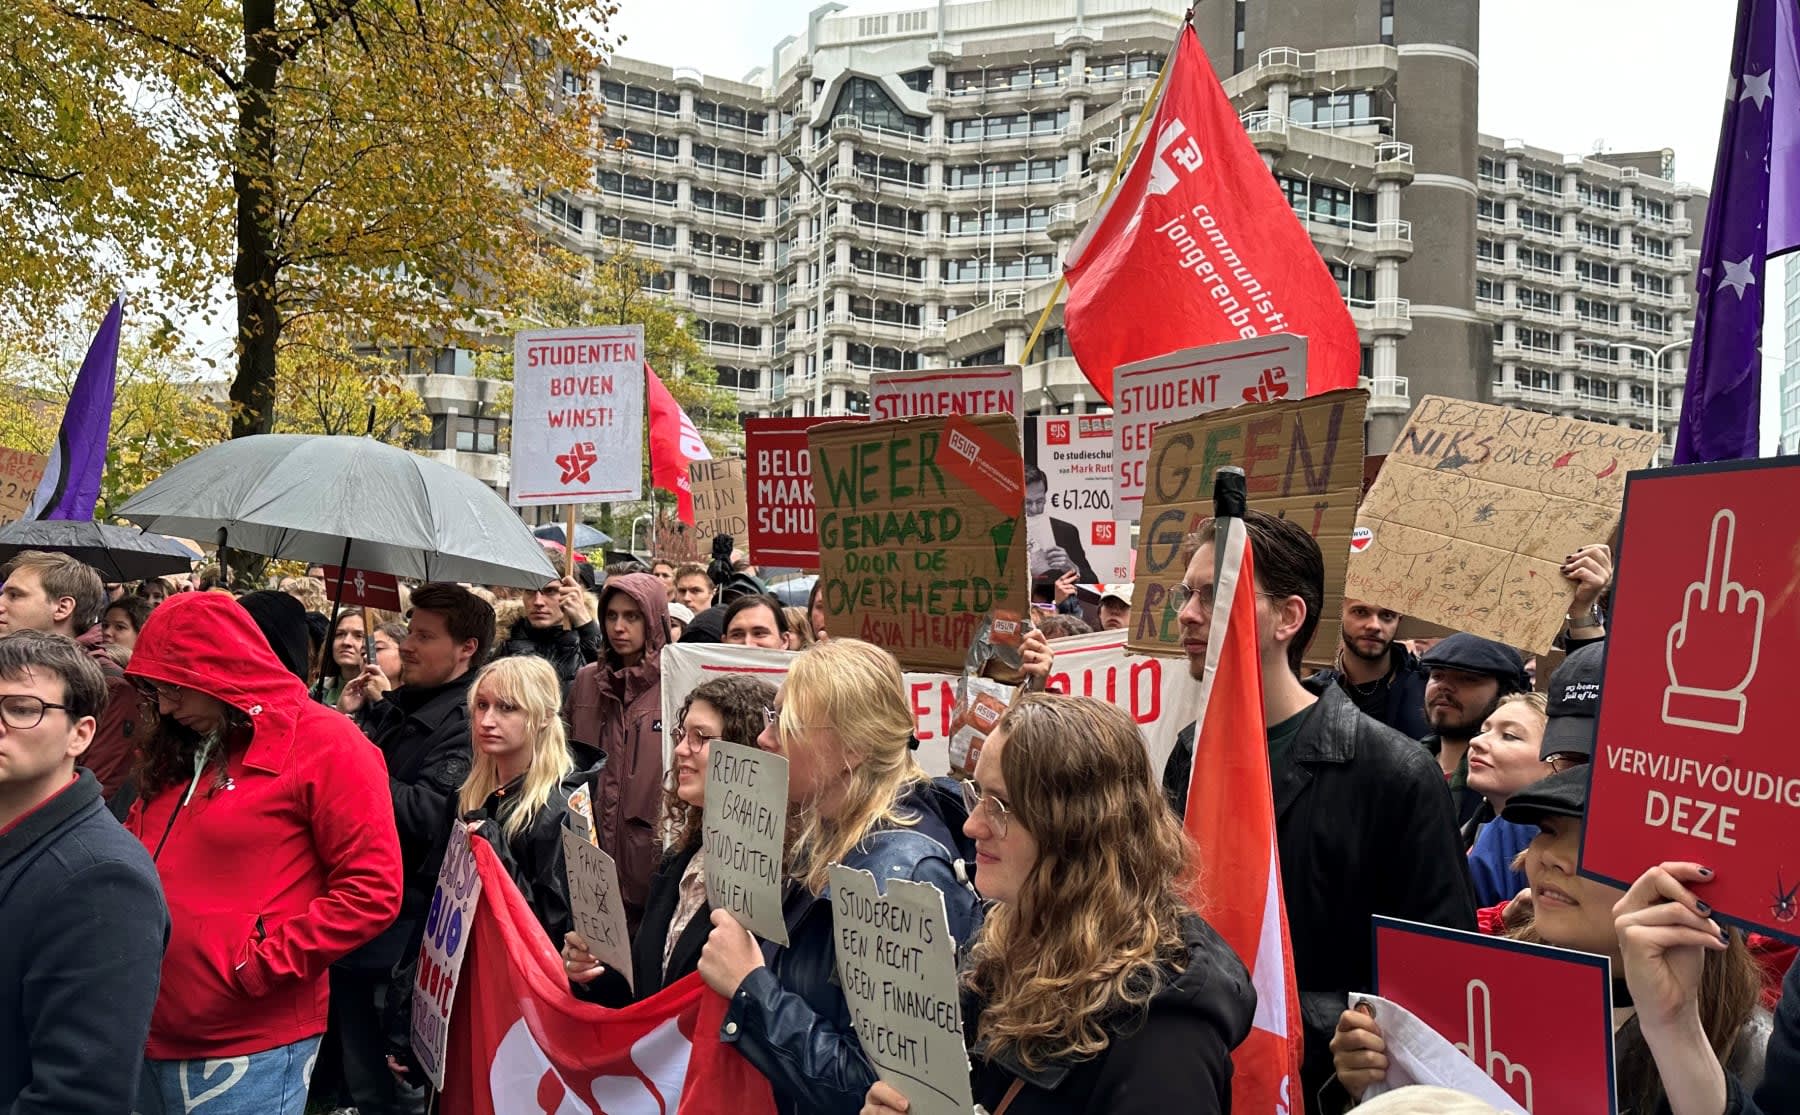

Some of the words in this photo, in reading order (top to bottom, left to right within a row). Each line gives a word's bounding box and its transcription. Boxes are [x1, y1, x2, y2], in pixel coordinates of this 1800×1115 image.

[1191, 204, 1290, 333] communisti
[527, 342, 637, 368] STUDENTEN
[550, 374, 614, 397] BOVEN
[1120, 374, 1221, 415] STUDENT
[548, 407, 614, 430] WINST!
[1415, 398, 1490, 428] DEZE
[1499, 410, 1557, 439] KIP
[758, 449, 811, 476] BELO
[950, 433, 977, 459] ASVA
[1053, 451, 1065, 460] De
[1155, 401, 1345, 505] GEEN
[1395, 426, 1495, 466] NIKS
[1494, 444, 1554, 467] OVER
[688, 461, 732, 483] NIET
[819, 431, 946, 512] WEER
[1071, 463, 1094, 474] Mark
[692, 488, 735, 511] MIJN
[758, 479, 815, 505] MAAK
[758, 507, 814, 534] SCHU
[821, 507, 961, 550] GENAAID
[845, 551, 900, 575] DOOR
[914, 549, 948, 571] DE
[995, 620, 1015, 632] ASVA
[977, 704, 997, 720] ASVA
[712, 750, 760, 787] RENTE
[1606, 744, 1800, 808] VERVIJFVOUDIG
[722, 789, 779, 841] GRAAIEN
[1644, 789, 1741, 847] DEZE
[705, 826, 780, 886] STUDENTEN
[839, 887, 912, 934] STUDEREN
[842, 928, 869, 958] EEN
[876, 935, 925, 981] RECHT,
[845, 961, 876, 1001] GEEN
